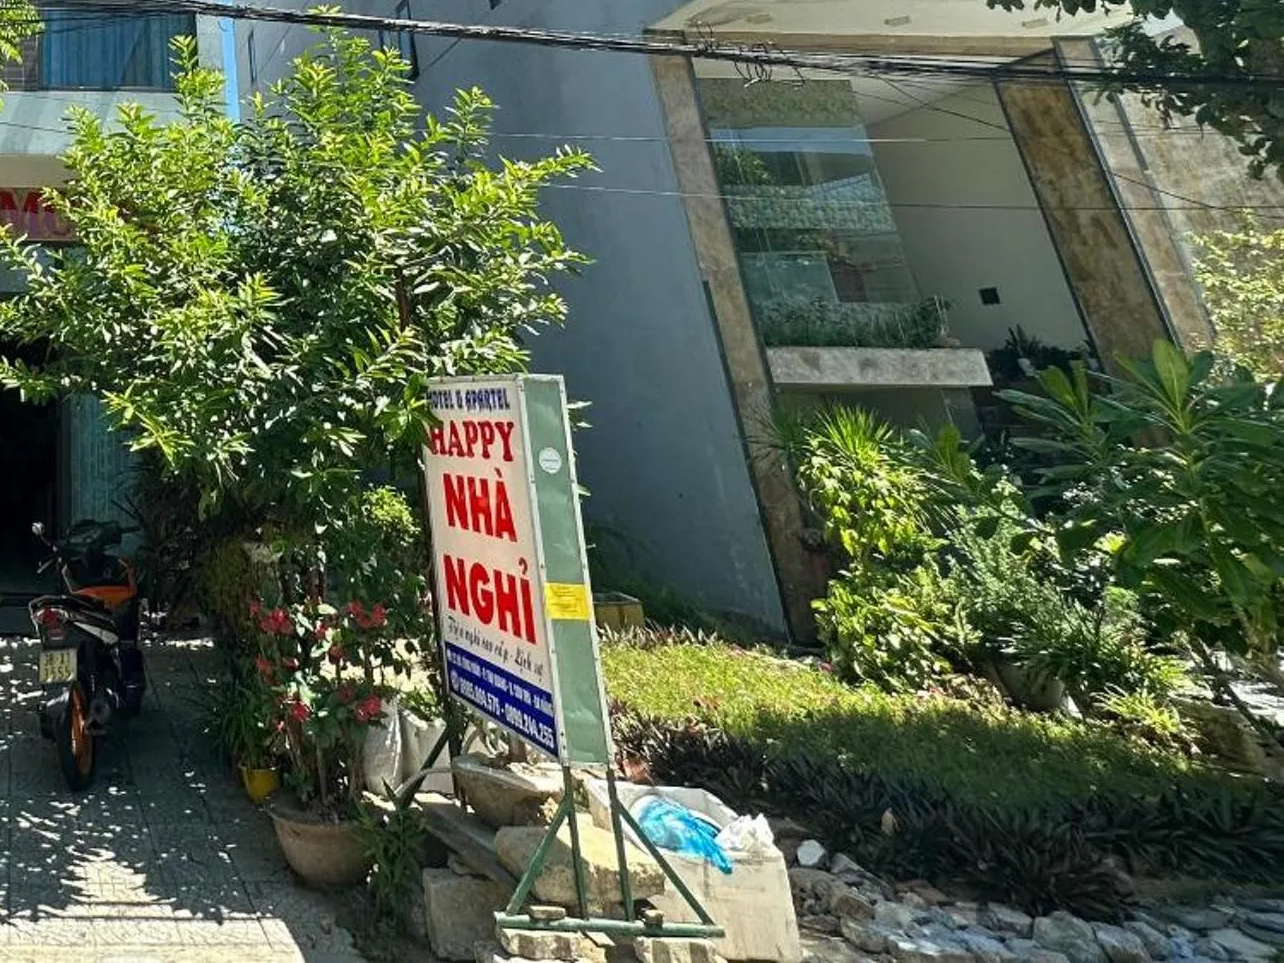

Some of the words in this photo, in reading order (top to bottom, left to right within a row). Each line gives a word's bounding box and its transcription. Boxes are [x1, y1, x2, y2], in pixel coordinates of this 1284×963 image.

[429, 418, 514, 462] HAPPY
[443, 467, 518, 542] NHÀ
[444, 555, 536, 645] NGHỈ
